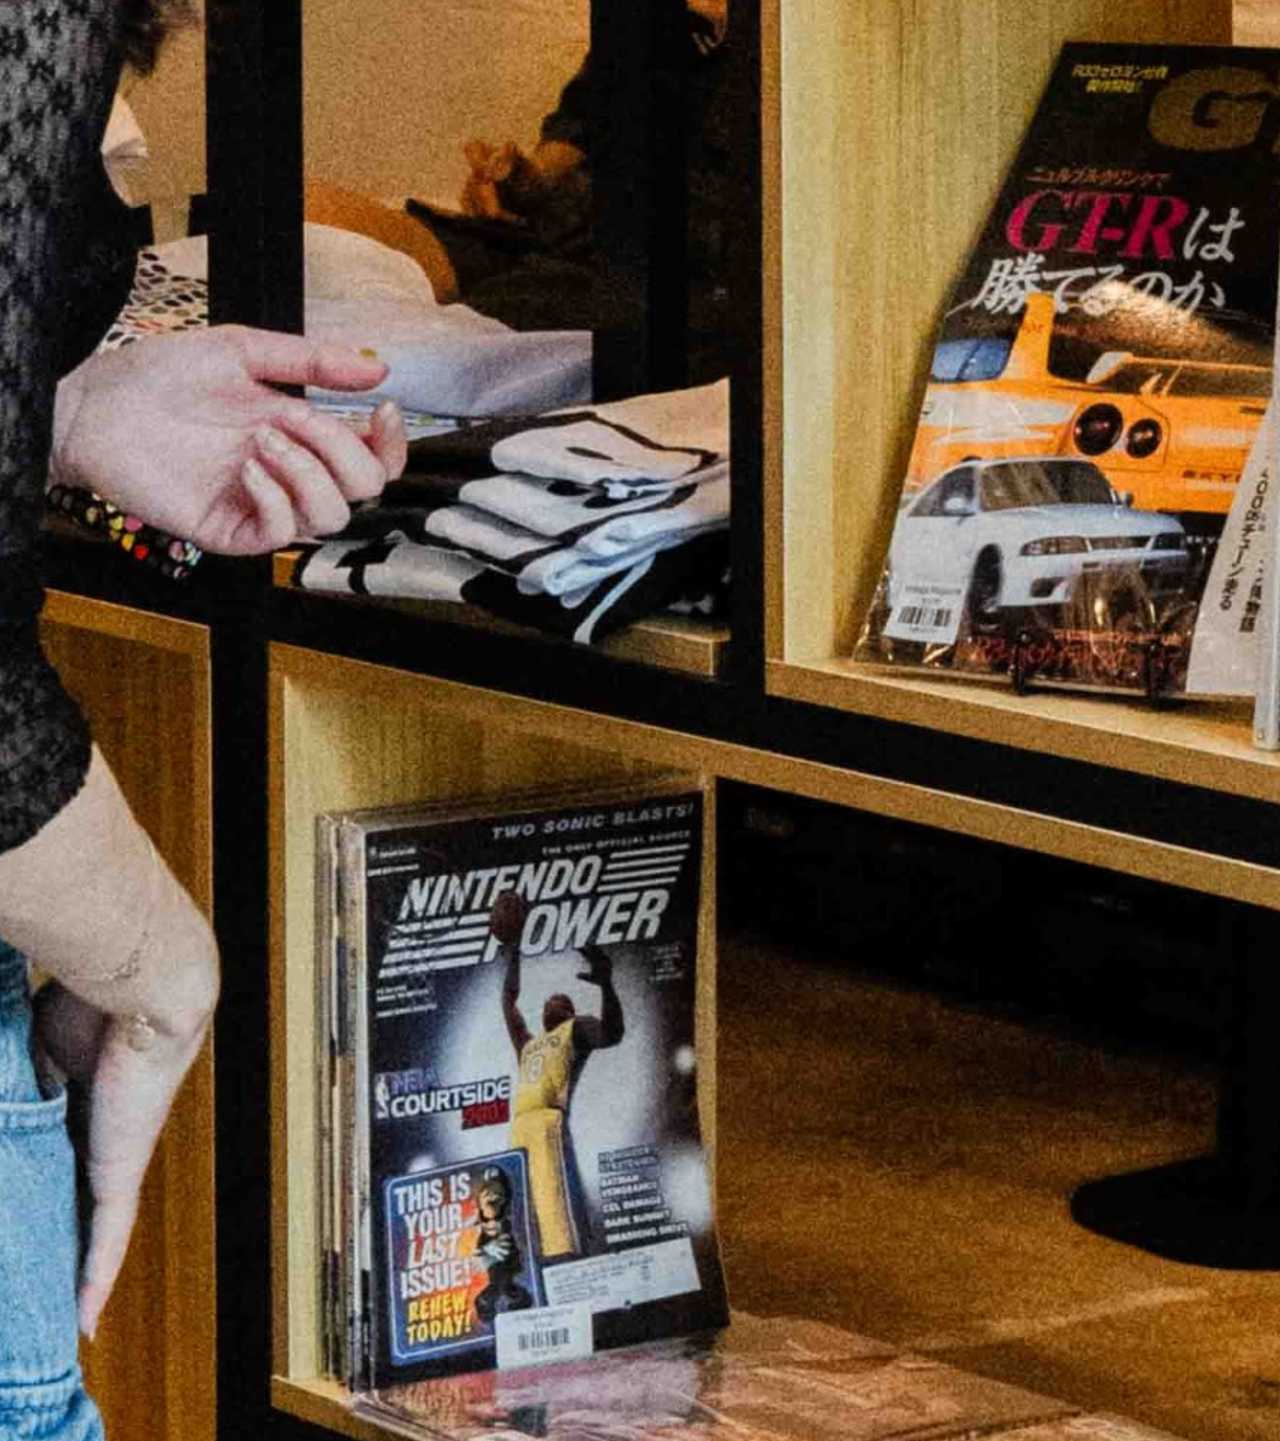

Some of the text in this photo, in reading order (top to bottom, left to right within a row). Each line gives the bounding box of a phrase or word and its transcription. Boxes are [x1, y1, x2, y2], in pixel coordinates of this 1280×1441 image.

[970, 251, 1226, 316] 勝てるのか
[543, 813, 606, 834] SONIC
[398, 855, 604, 922] NINTENDO
[390, 1076, 512, 1120] COURTSIDE
[393, 1172, 471, 1215] THIS IS
[404, 1203, 463, 1241] YOUR
[408, 1232, 462, 1271] LAST
[401, 1260, 469, 1300] ISSUE!
[407, 1314, 471, 1346] TODAY!
